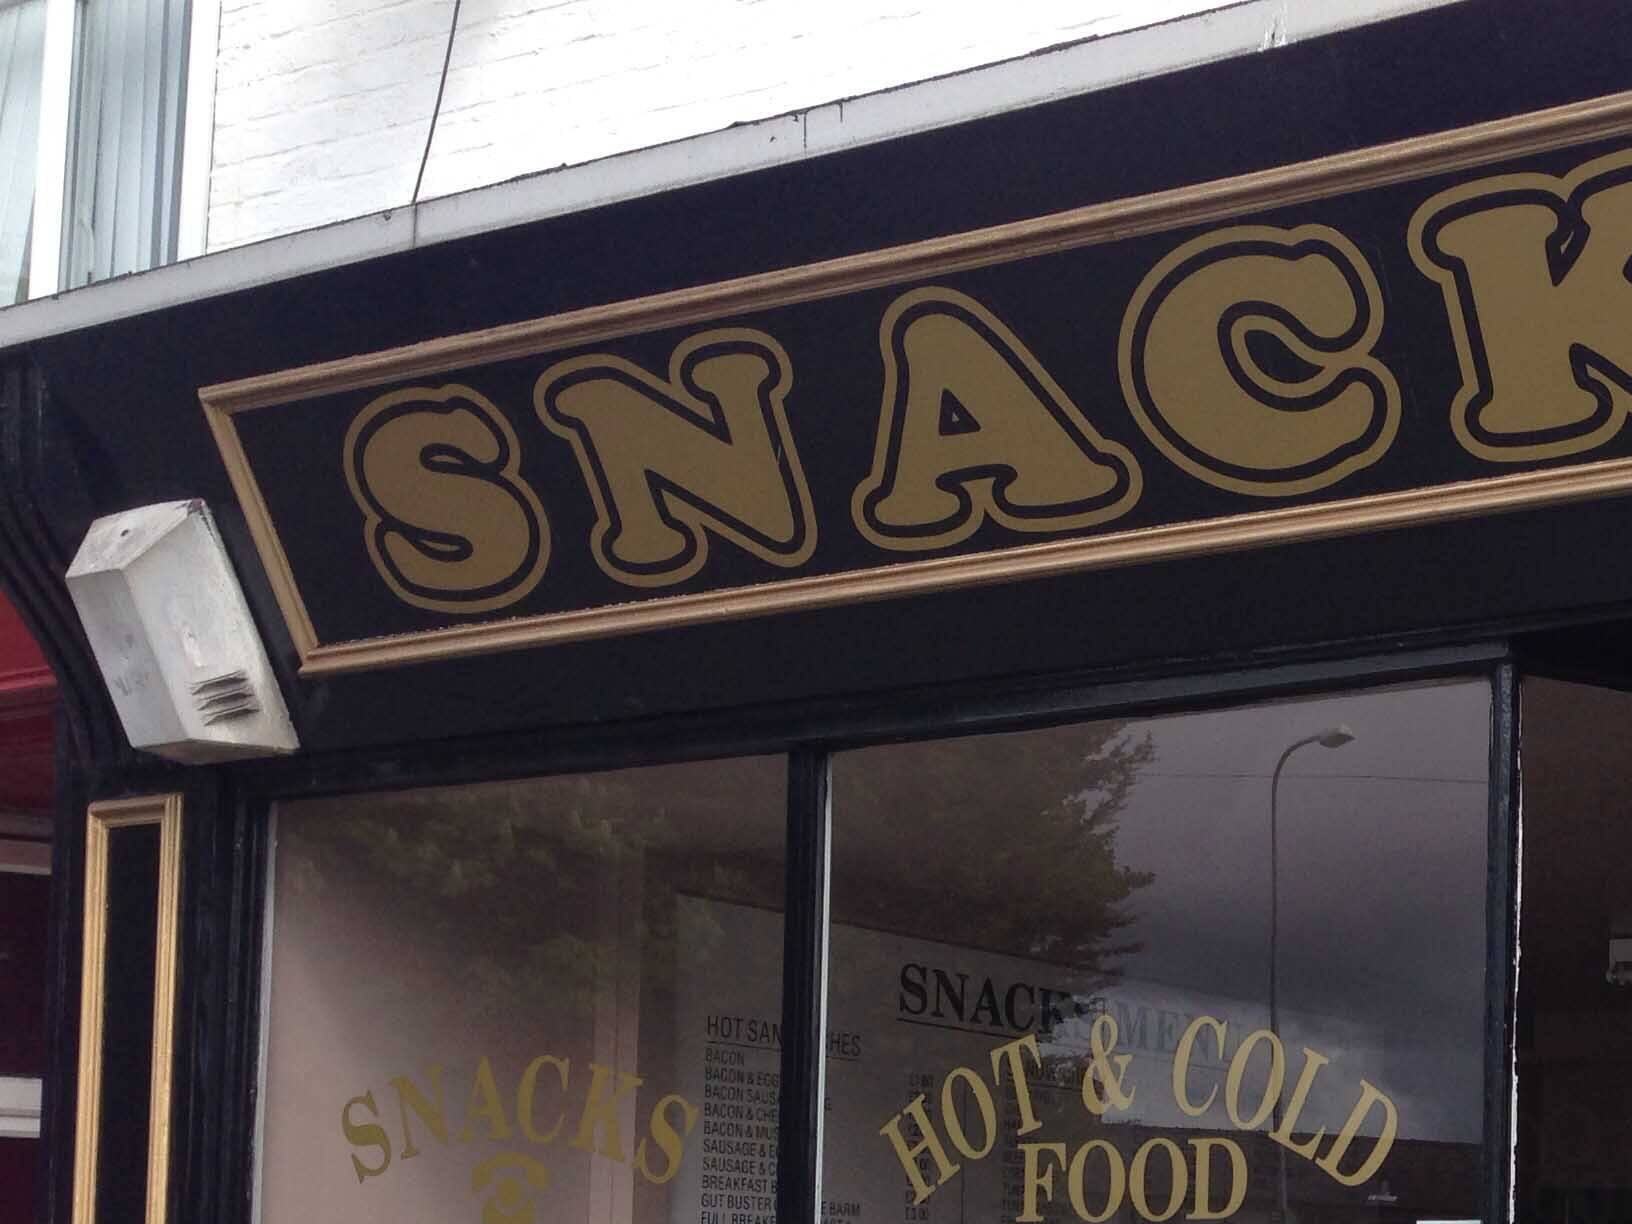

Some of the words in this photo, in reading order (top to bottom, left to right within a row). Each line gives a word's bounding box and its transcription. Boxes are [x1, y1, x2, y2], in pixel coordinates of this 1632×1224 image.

[706, 1015, 744, 1039] HOT
[705, 1048, 744, 1066] BACON
[705, 1067, 744, 1084] BACON
[747, 1072, 754, 1085] &
[705, 1084, 744, 1102] BACON
[341, 1055, 699, 1184] SNACKS
[704, 1102, 743, 1119] BACON
[745, 1107, 753, 1121] &
[880, 1034, 1044, 1205] HOT
[1081, 1016, 1136, 1114] &
[1172, 1016, 1398, 1187] COLD
[704, 1120, 743, 1138] BACON
[745, 1124, 753, 1138] &
[703, 1139, 757, 1157] SAUSAGE
[759, 1144, 766, 1158] &
[703, 1157, 757, 1175] SAUSAGE
[759, 1161, 766, 1176] &
[702, 1174, 767, 1193] BREAKFAST
[1017, 1138, 1247, 1223] FOOD
[701, 1193, 725, 1208] GUT
[727, 1194, 771, 1212] BUSTER
